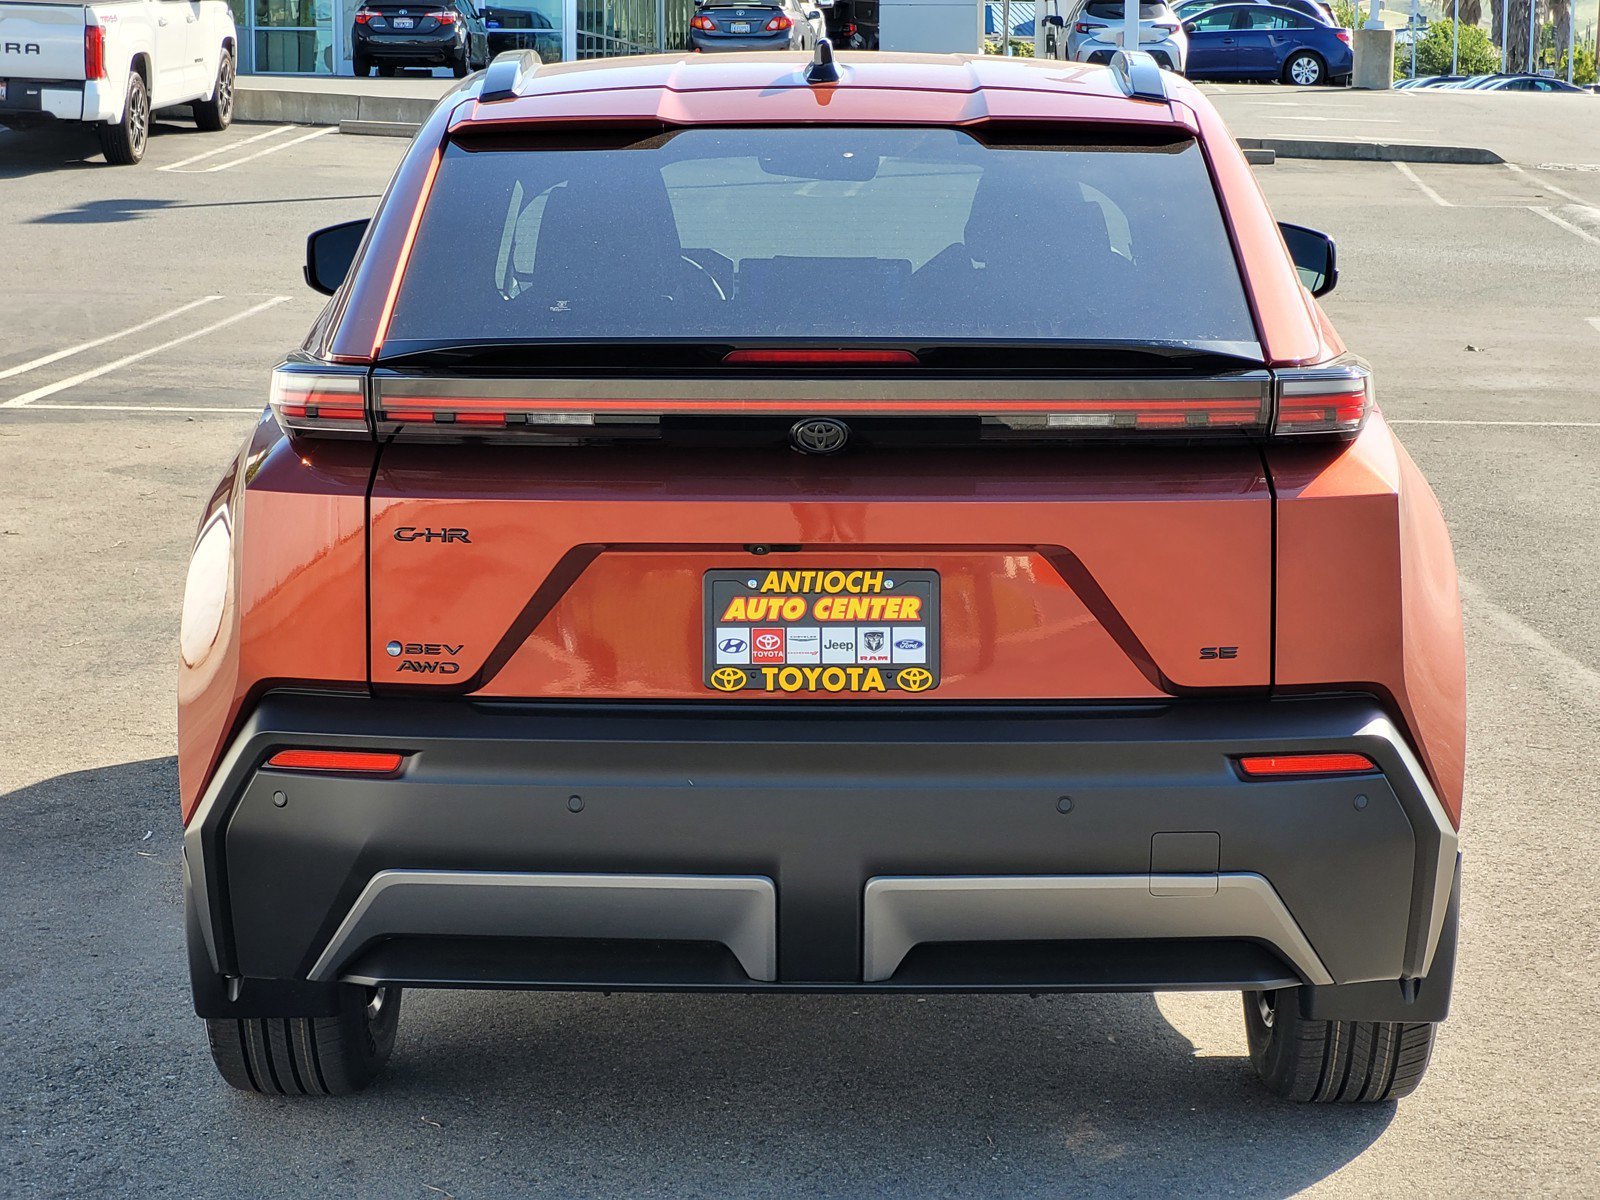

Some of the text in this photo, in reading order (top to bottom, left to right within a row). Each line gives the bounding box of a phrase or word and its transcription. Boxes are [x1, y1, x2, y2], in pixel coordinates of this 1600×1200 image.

[393, 527, 472, 543] C-HR
[760, 571, 884, 594] ANTIOCH
[721, 596, 923, 622] AUTO CENTER
[404, 643, 464, 655] BEV
[824, 639, 854, 652] Jeep
[752, 650, 784, 658] TOYOTA
[1199, 646, 1239, 660] SE
[396, 660, 460, 674] AWD
[761, 667, 886, 693] TOYOTA
